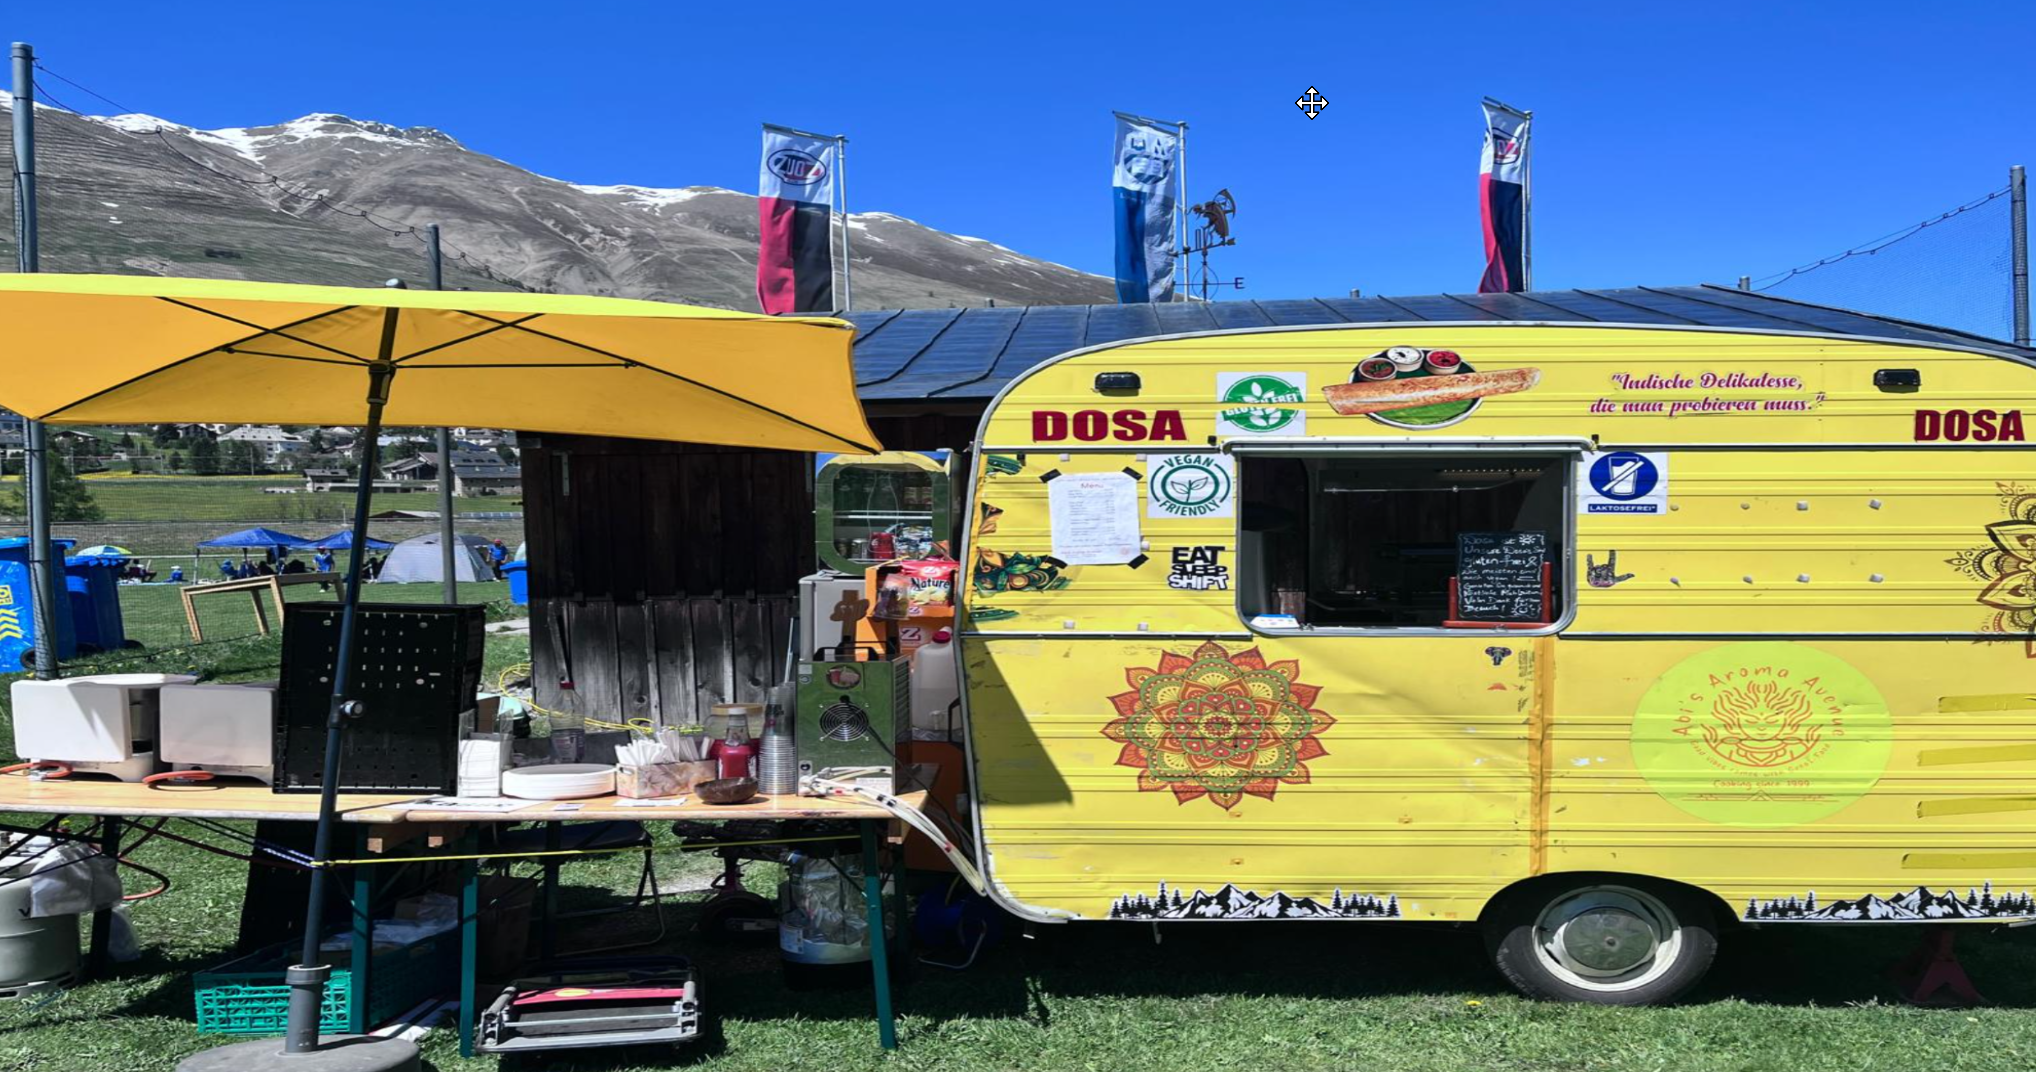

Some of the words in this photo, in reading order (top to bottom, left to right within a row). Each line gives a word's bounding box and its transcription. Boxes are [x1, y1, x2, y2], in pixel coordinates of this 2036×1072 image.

[773, 154, 824, 179] ZUOZ
[1235, 277, 1245, 289] E
[1700, 372, 1803, 390] Delikatesse,
[1590, 398, 1616, 413] die
[1622, 400, 1663, 413] man
[1668, 397, 1757, 418] probieren
[1032, 410, 1188, 442] DOSA
[1914, 409, 2025, 442] DOSA
[1164, 454, 1215, 468] VEGAN
[1159, 499, 1221, 516] FRIENDLY
[1172, 546, 1225, 565] EAT
[1171, 563, 1228, 576] SLEEP
[911, 577, 951, 591] Nature
[1167, 573, 1230, 591] SHIFT
[901, 627, 921, 641] Z
[1672, 692, 1704, 737] Abi's
[1708, 666, 1790, 689] Aroma
[1802, 676, 1846, 737] Avenue
